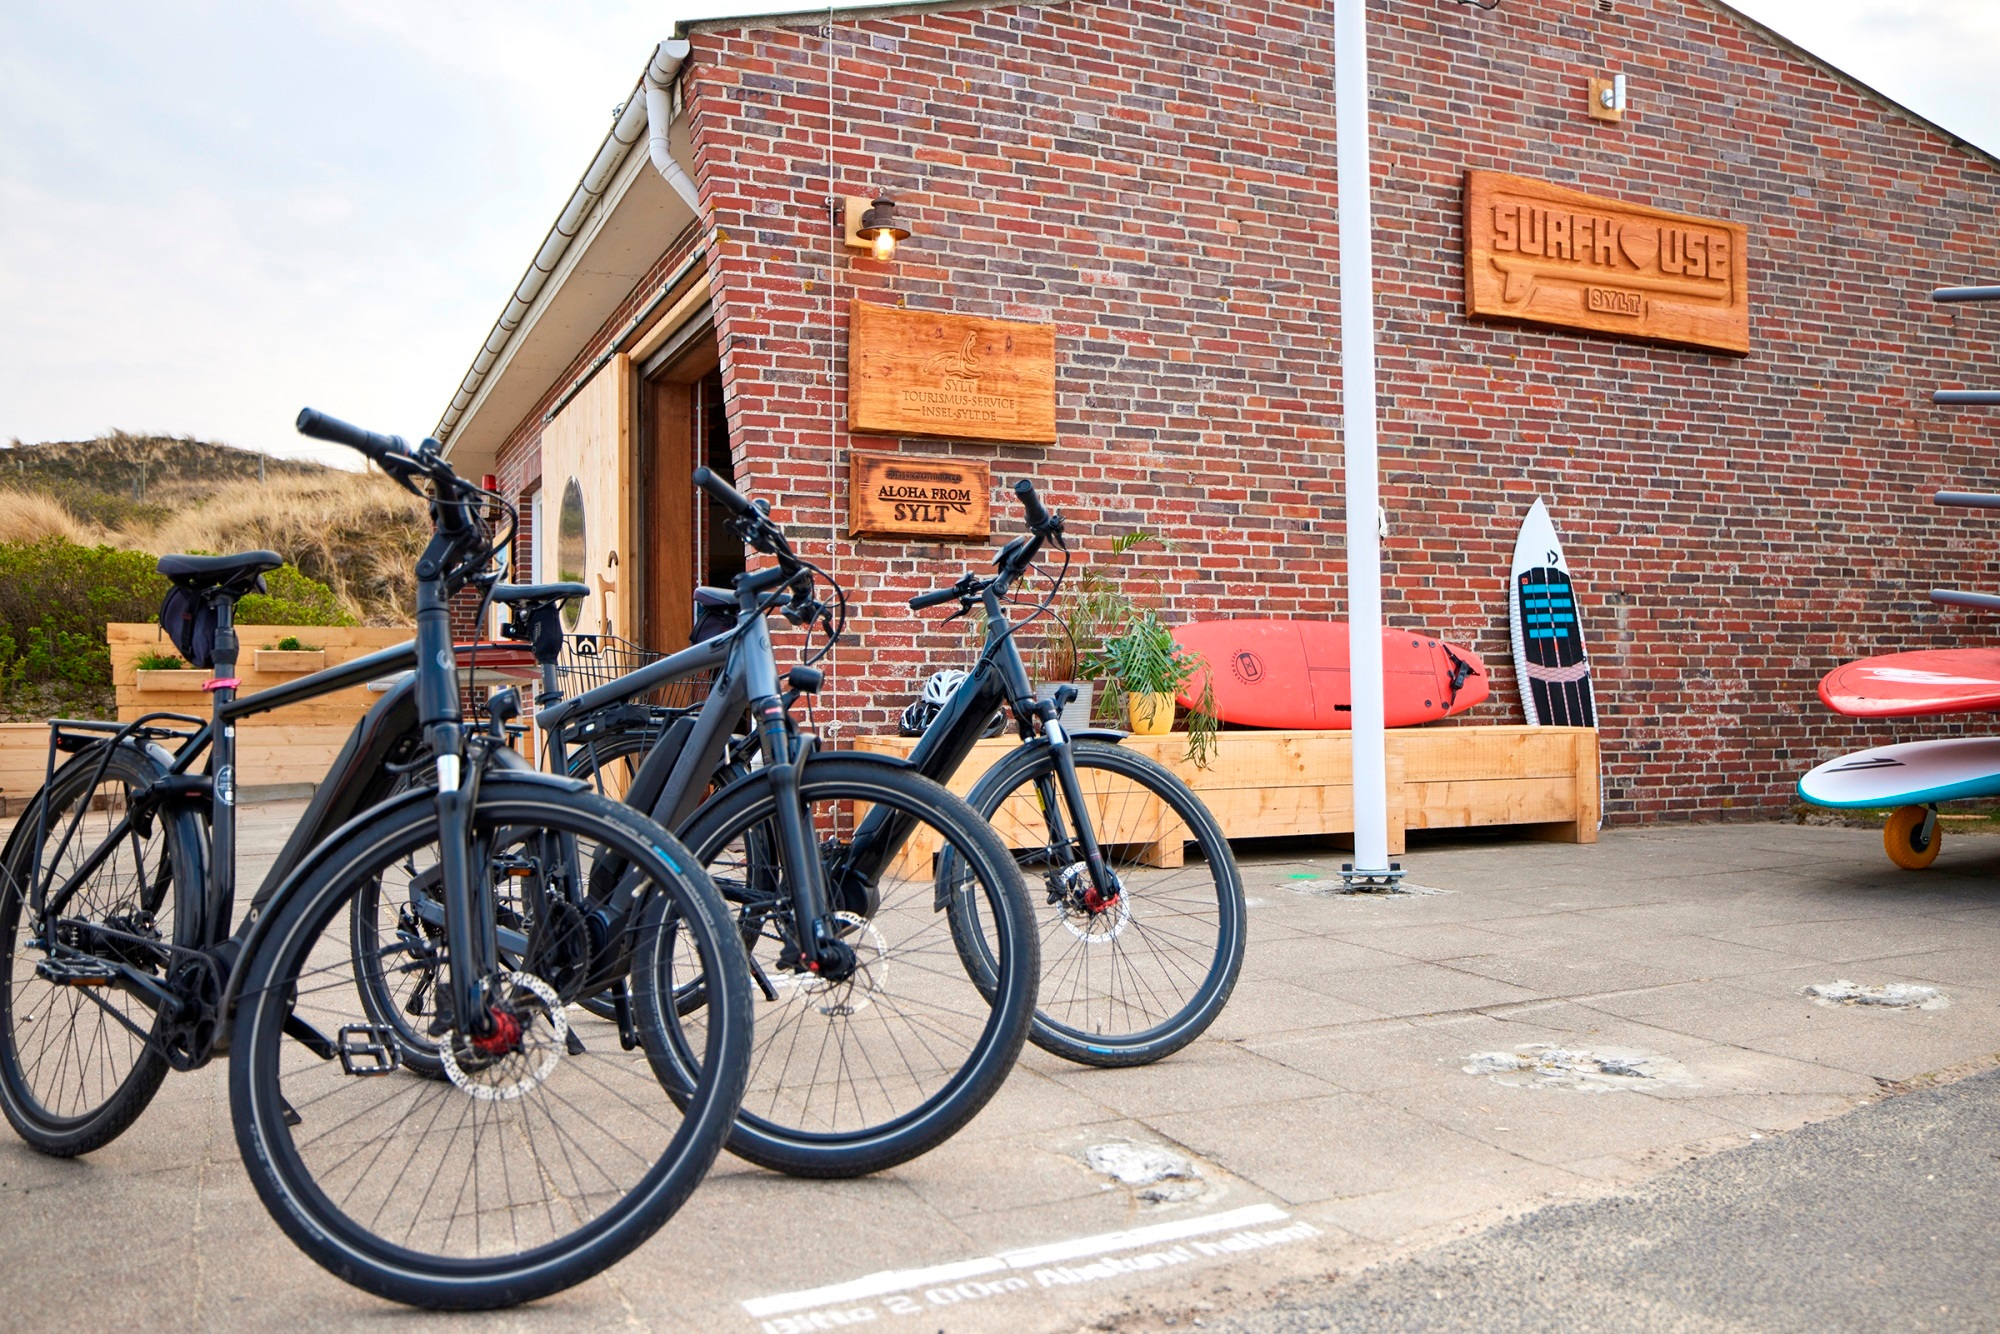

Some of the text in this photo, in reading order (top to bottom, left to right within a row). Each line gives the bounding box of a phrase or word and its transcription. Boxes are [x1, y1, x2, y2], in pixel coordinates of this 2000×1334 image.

[1590, 288, 1641, 313] SYLT
[944, 378, 975, 393] SYLT
[901, 390, 1015, 410] TOURISMUS-SERVICE
[921, 405, 997, 421] INSEL-SYLT.DE
[878, 485, 971, 502] ALOHA FROM
[894, 502, 950, 523] SYLT
